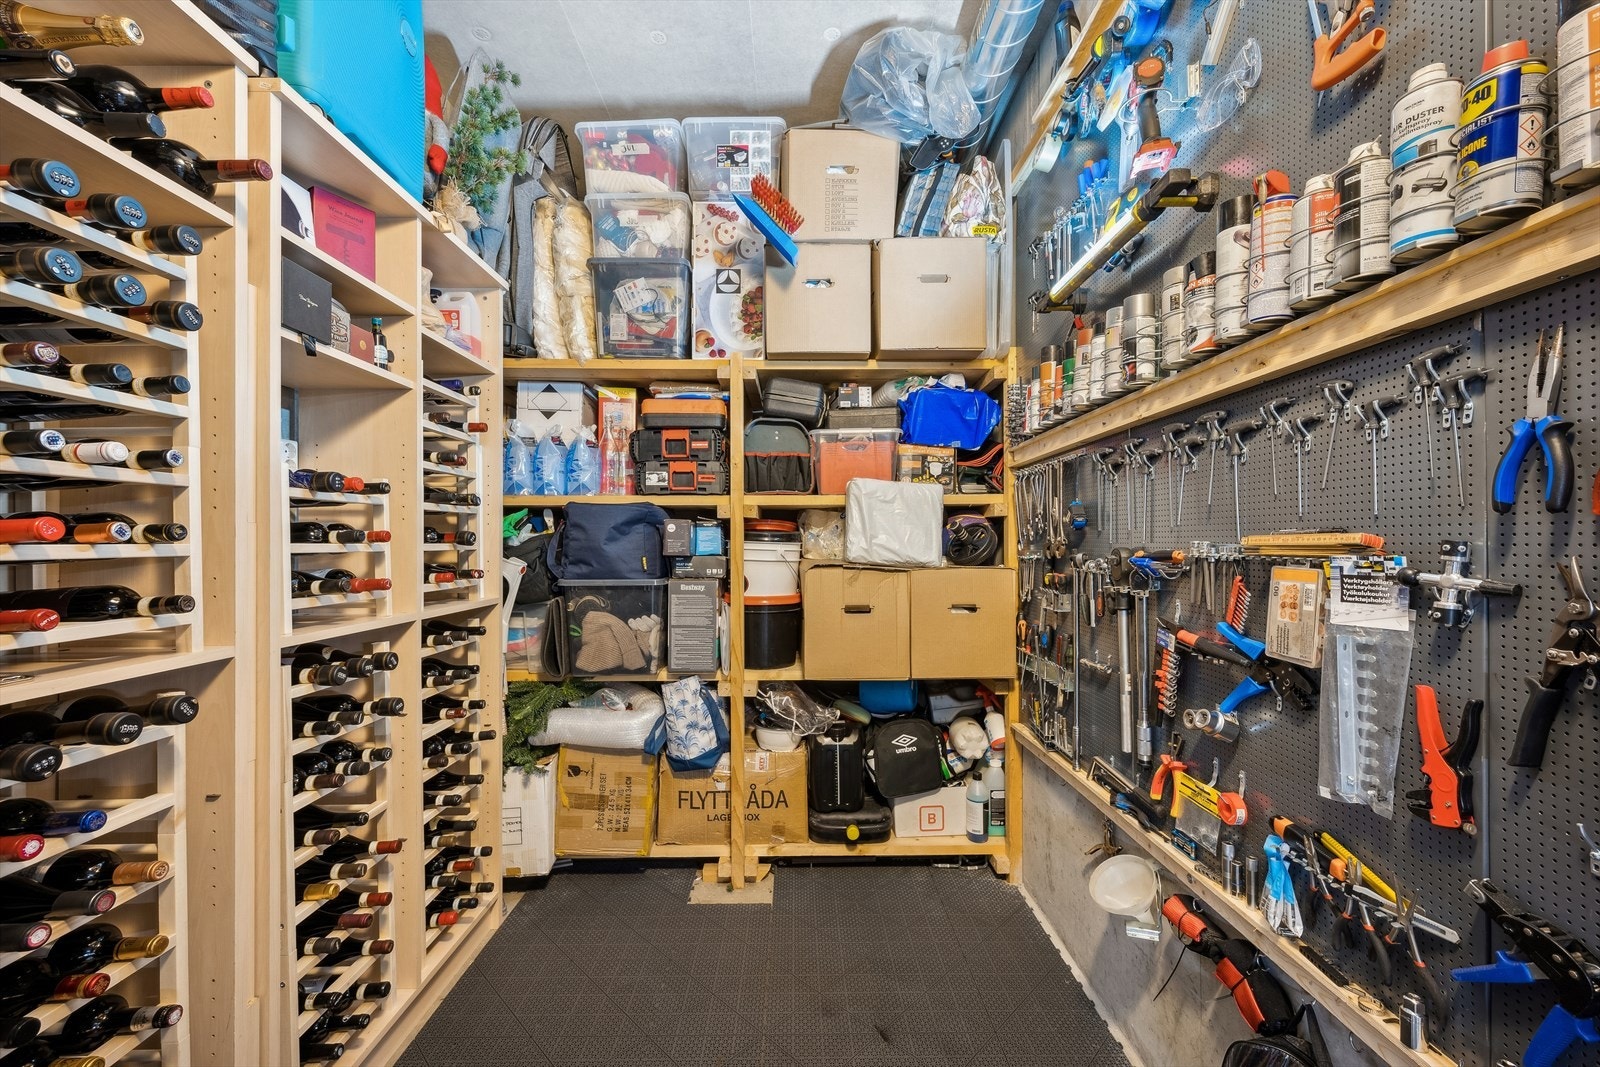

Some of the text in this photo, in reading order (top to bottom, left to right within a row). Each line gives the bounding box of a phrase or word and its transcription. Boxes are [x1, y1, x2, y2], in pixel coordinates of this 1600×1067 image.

[1461, 85, 1492, 114] D-40
[1405, 105, 1445, 125] DUSTER
[621, 144, 635, 153] JUL
[895, 746, 917, 754] umbro
[678, 783, 789, 810] FLYTTÅDA
[927, 813, 936, 824] B
